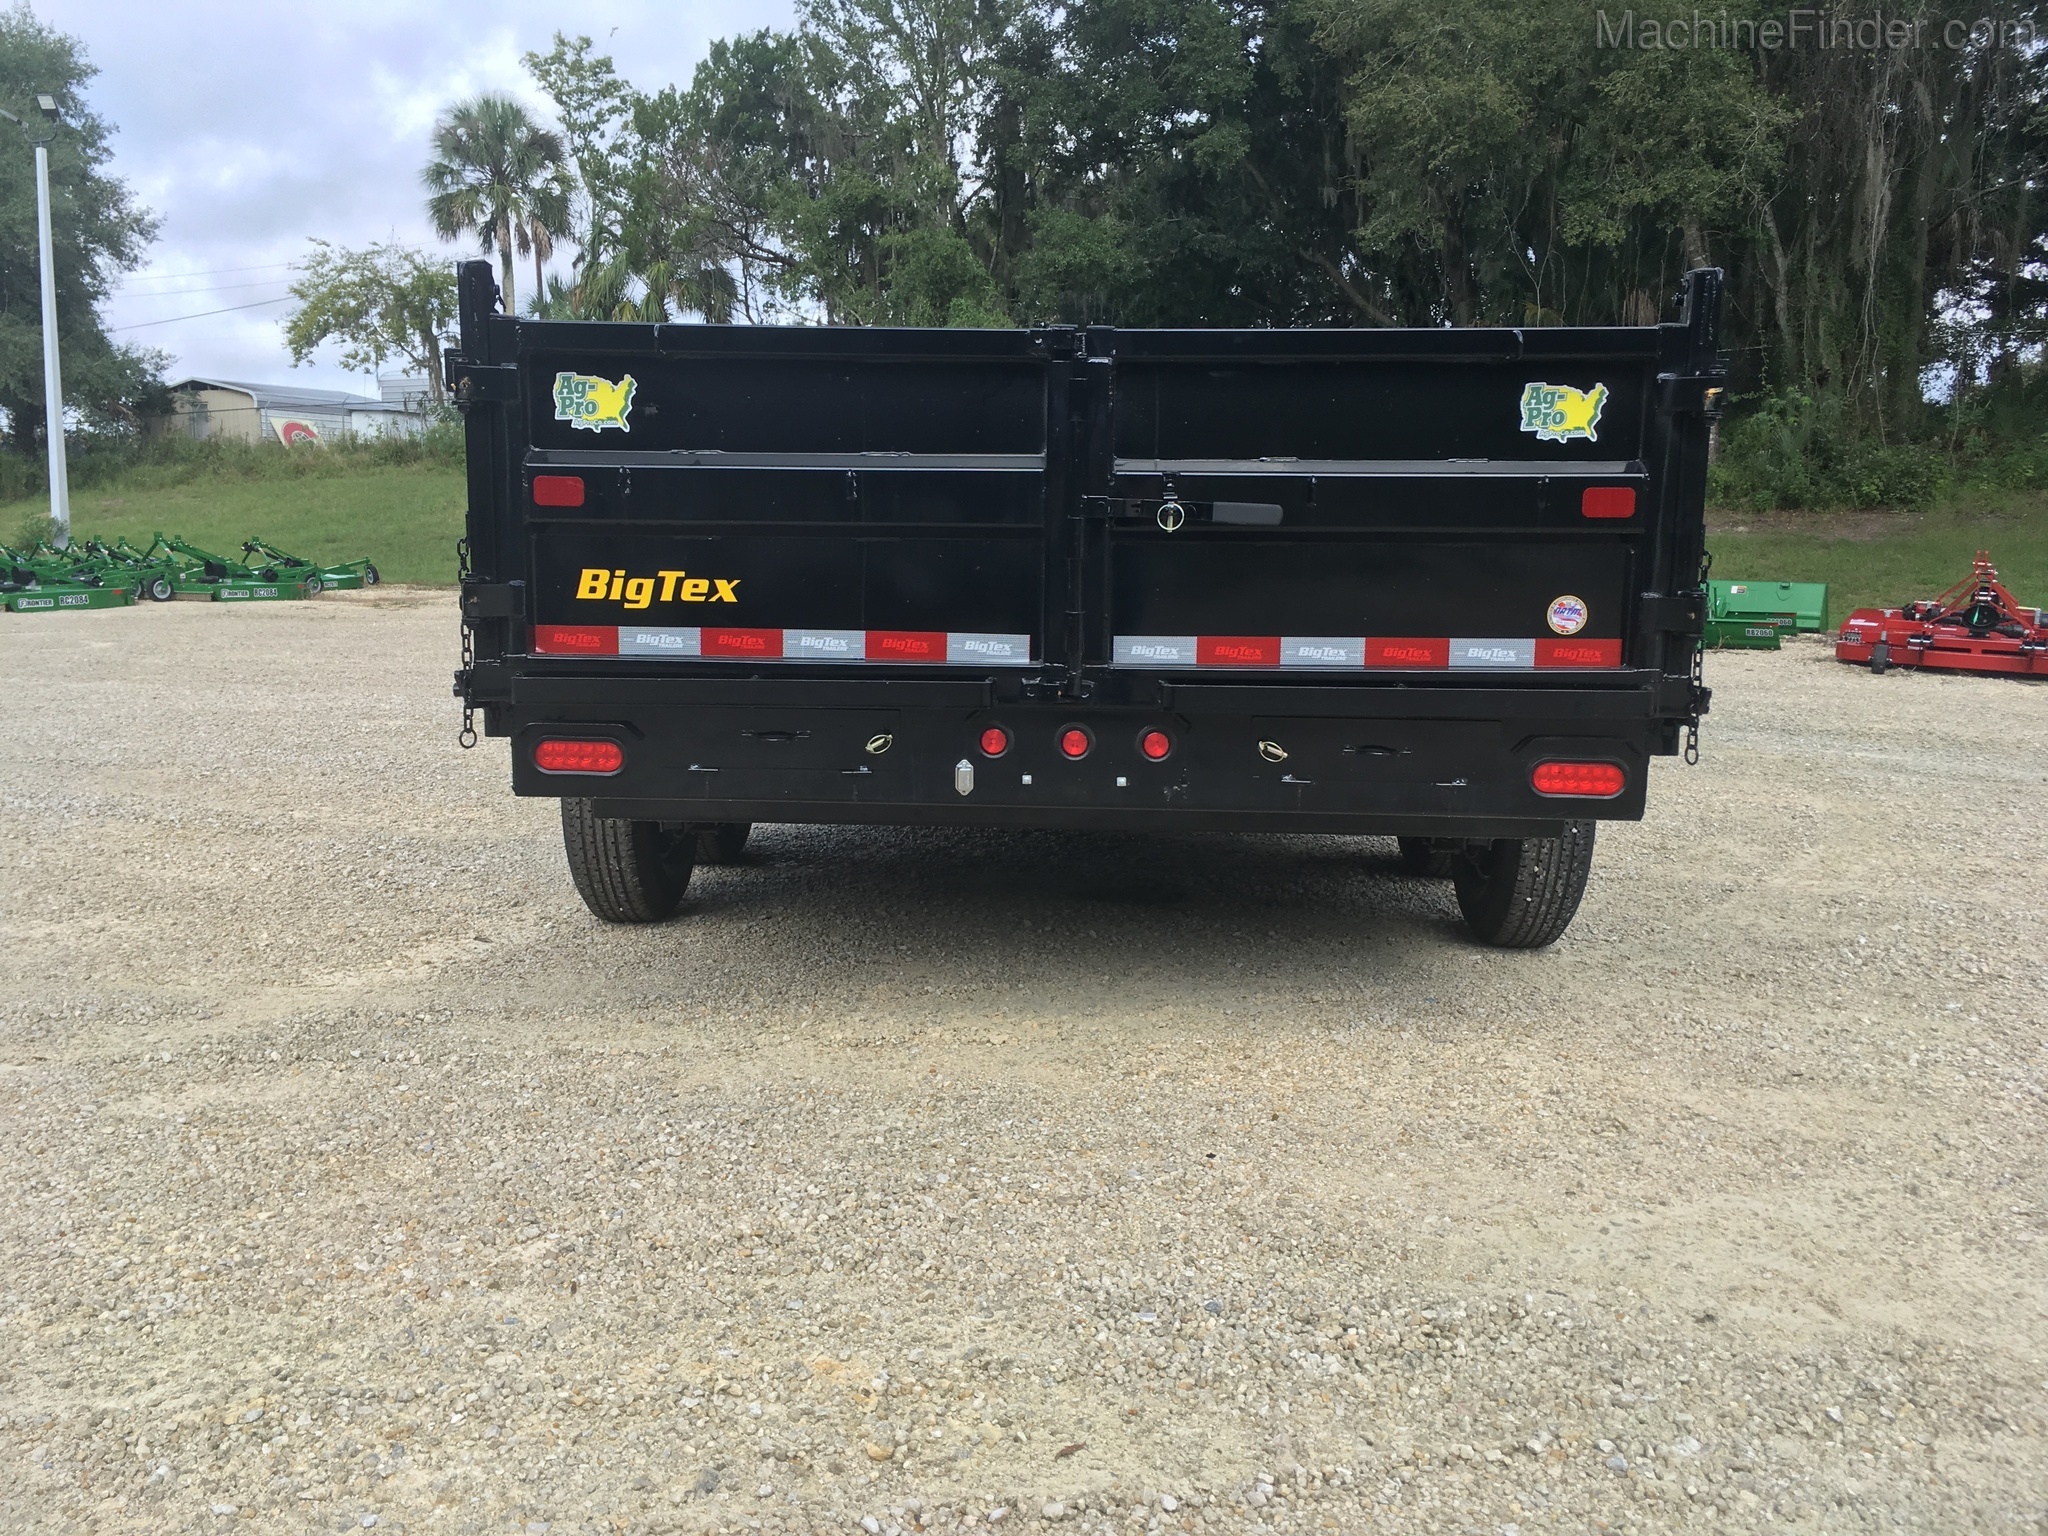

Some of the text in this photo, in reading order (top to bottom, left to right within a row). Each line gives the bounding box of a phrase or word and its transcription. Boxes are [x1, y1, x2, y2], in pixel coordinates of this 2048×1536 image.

[558, 396, 598, 417] Pro
[1525, 407, 1567, 429] Pro
[576, 569, 741, 609] BigTex
[18, 595, 89, 608] FRONTIER RC2084
[1746, 628, 1774, 637] RB2060
[554, 633, 600, 645] BigTex
[637, 634, 683, 645] BigTex
[718, 635, 765, 647] BigTex
[800, 637, 848, 648] BigTex
[882, 638, 929, 650] BigTex
[964, 640, 1012, 652] BigTex
[1131, 645, 1179, 657] BigTex
[1215, 646, 1263, 658] BigTex
[1299, 647, 1347, 658] BigTex
[1383, 648, 1431, 659] BigTex
[1467, 648, 1516, 660] BigTex
[1553, 648, 1602, 660] BigTex
